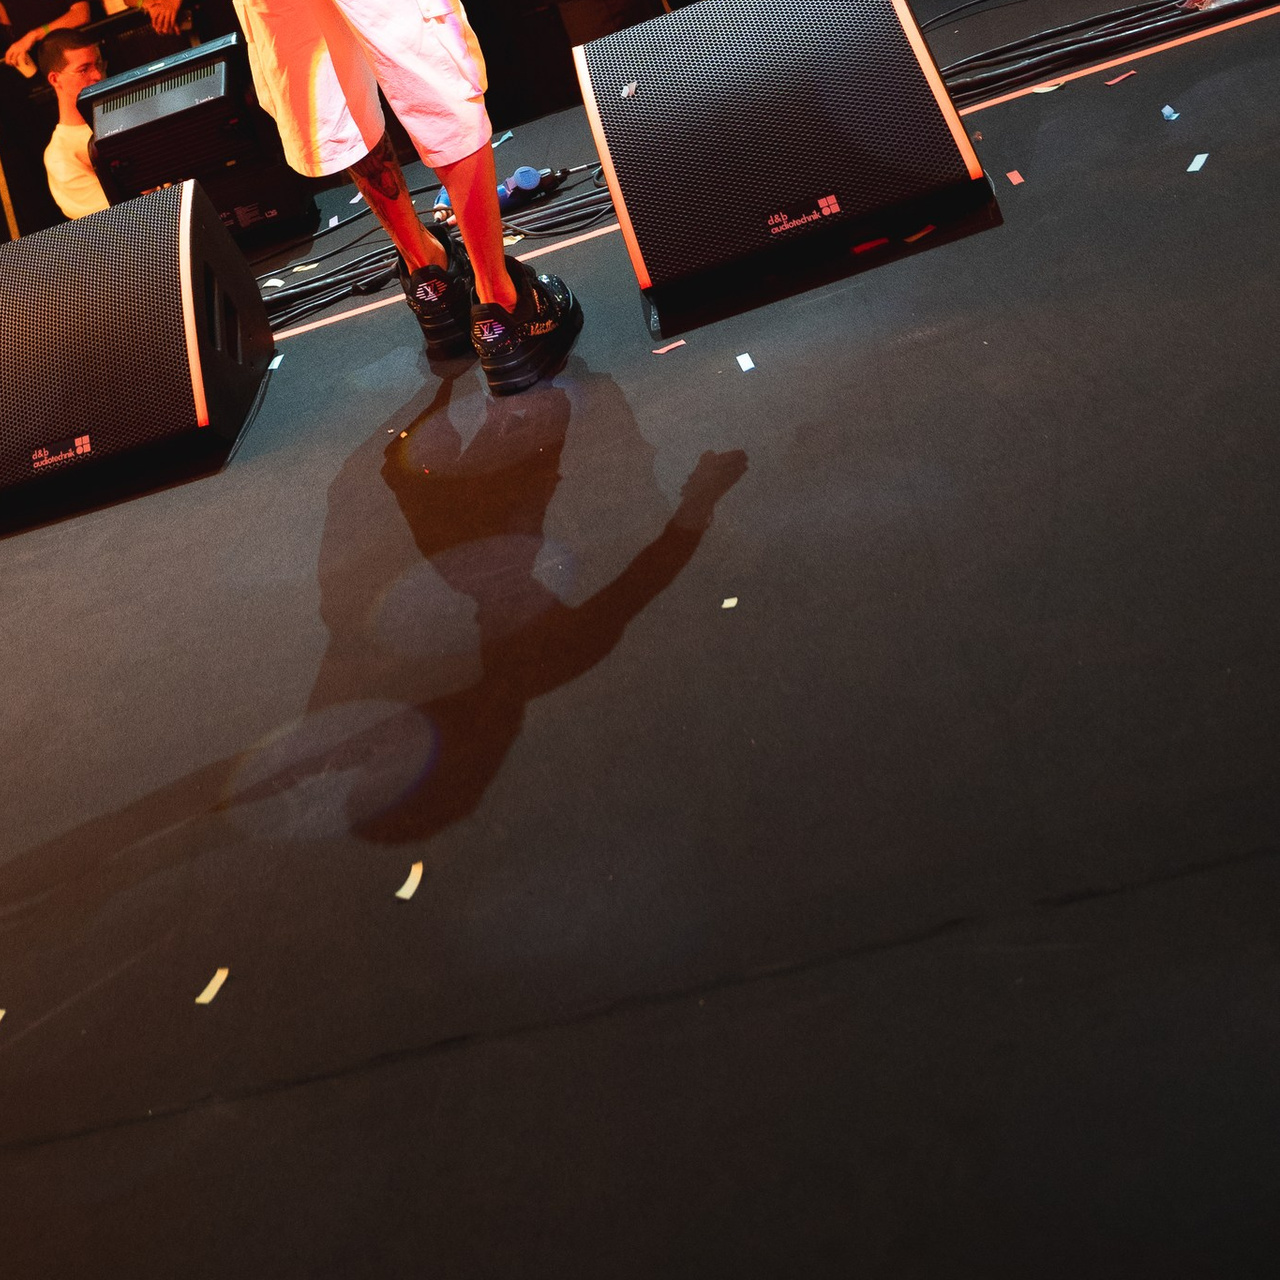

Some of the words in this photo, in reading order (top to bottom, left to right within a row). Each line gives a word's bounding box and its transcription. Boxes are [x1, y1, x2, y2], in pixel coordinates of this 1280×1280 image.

[767, 211, 788, 226] d&b
[770, 209, 822, 235] audiotechnik
[31, 447, 50, 461] d&b
